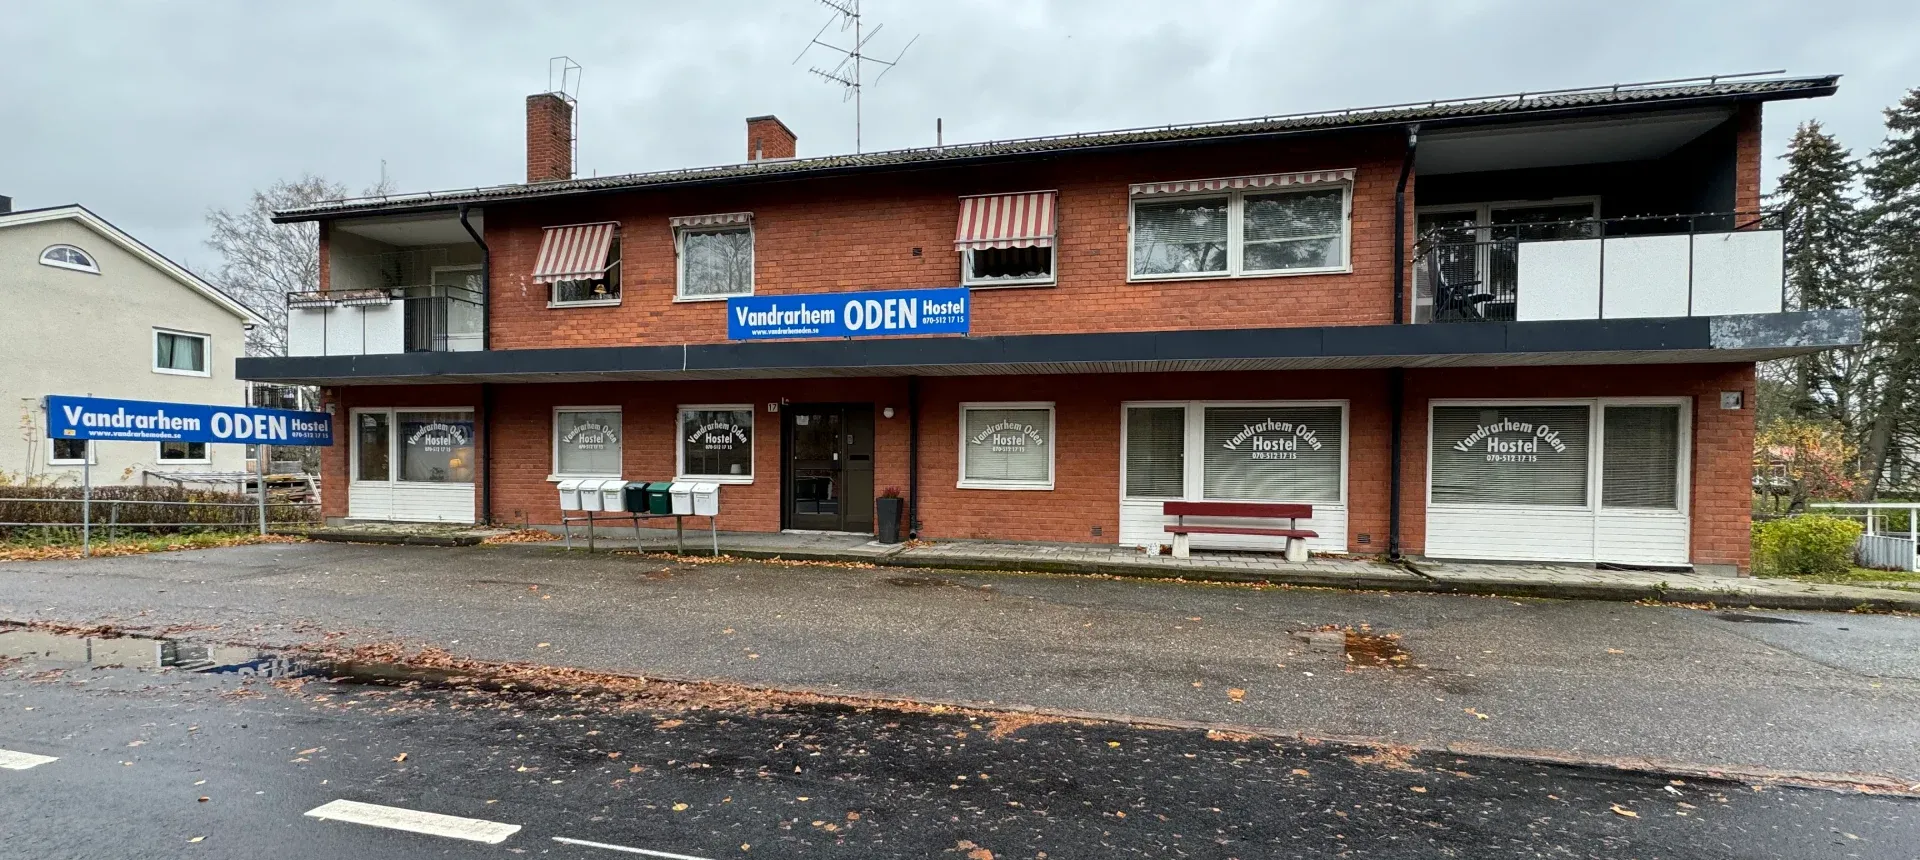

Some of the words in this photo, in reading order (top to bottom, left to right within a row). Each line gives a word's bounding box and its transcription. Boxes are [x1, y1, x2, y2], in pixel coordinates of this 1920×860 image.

[736, 303, 835, 326] Vandrarhem
[844, 298, 917, 330] ODEN
[923, 297, 964, 315] Hostel
[752, 327, 819, 336] www.vandrarhemoden.se
[768, 403, 777, 411] 17
[63, 405, 200, 430] Vandrarhem
[211, 412, 287, 440] ODEN
[292, 418, 328, 431] Hostel
[88, 430, 181, 439] www.vandrarhemoden.se
[408, 420, 448, 445] Vandrarhem
[450, 425, 465, 445] Oden
[425, 434, 451, 445] Hostel
[562, 420, 600, 443] Vandrarhem
[603, 425, 616, 443] Oden
[579, 433, 603, 443] Hostel
[687, 420, 729, 443] Vandrarhem
[731, 425, 747, 443] Oden
[705, 432, 732, 443] Hostel
[971, 419, 1022, 445] Vandrarhem
[1024, 425, 1043, 445] Oden
[993, 433, 1024, 445] Hostel
[1223, 418, 1292, 450] Vandrarhem
[1296, 424, 1322, 450] Oden
[1453, 417, 1532, 451] Vandrarhem
[1536, 425, 1566, 453] Oden
[1253, 435, 1296, 450] Hostel
[1487, 436, 1537, 452] Hostel
